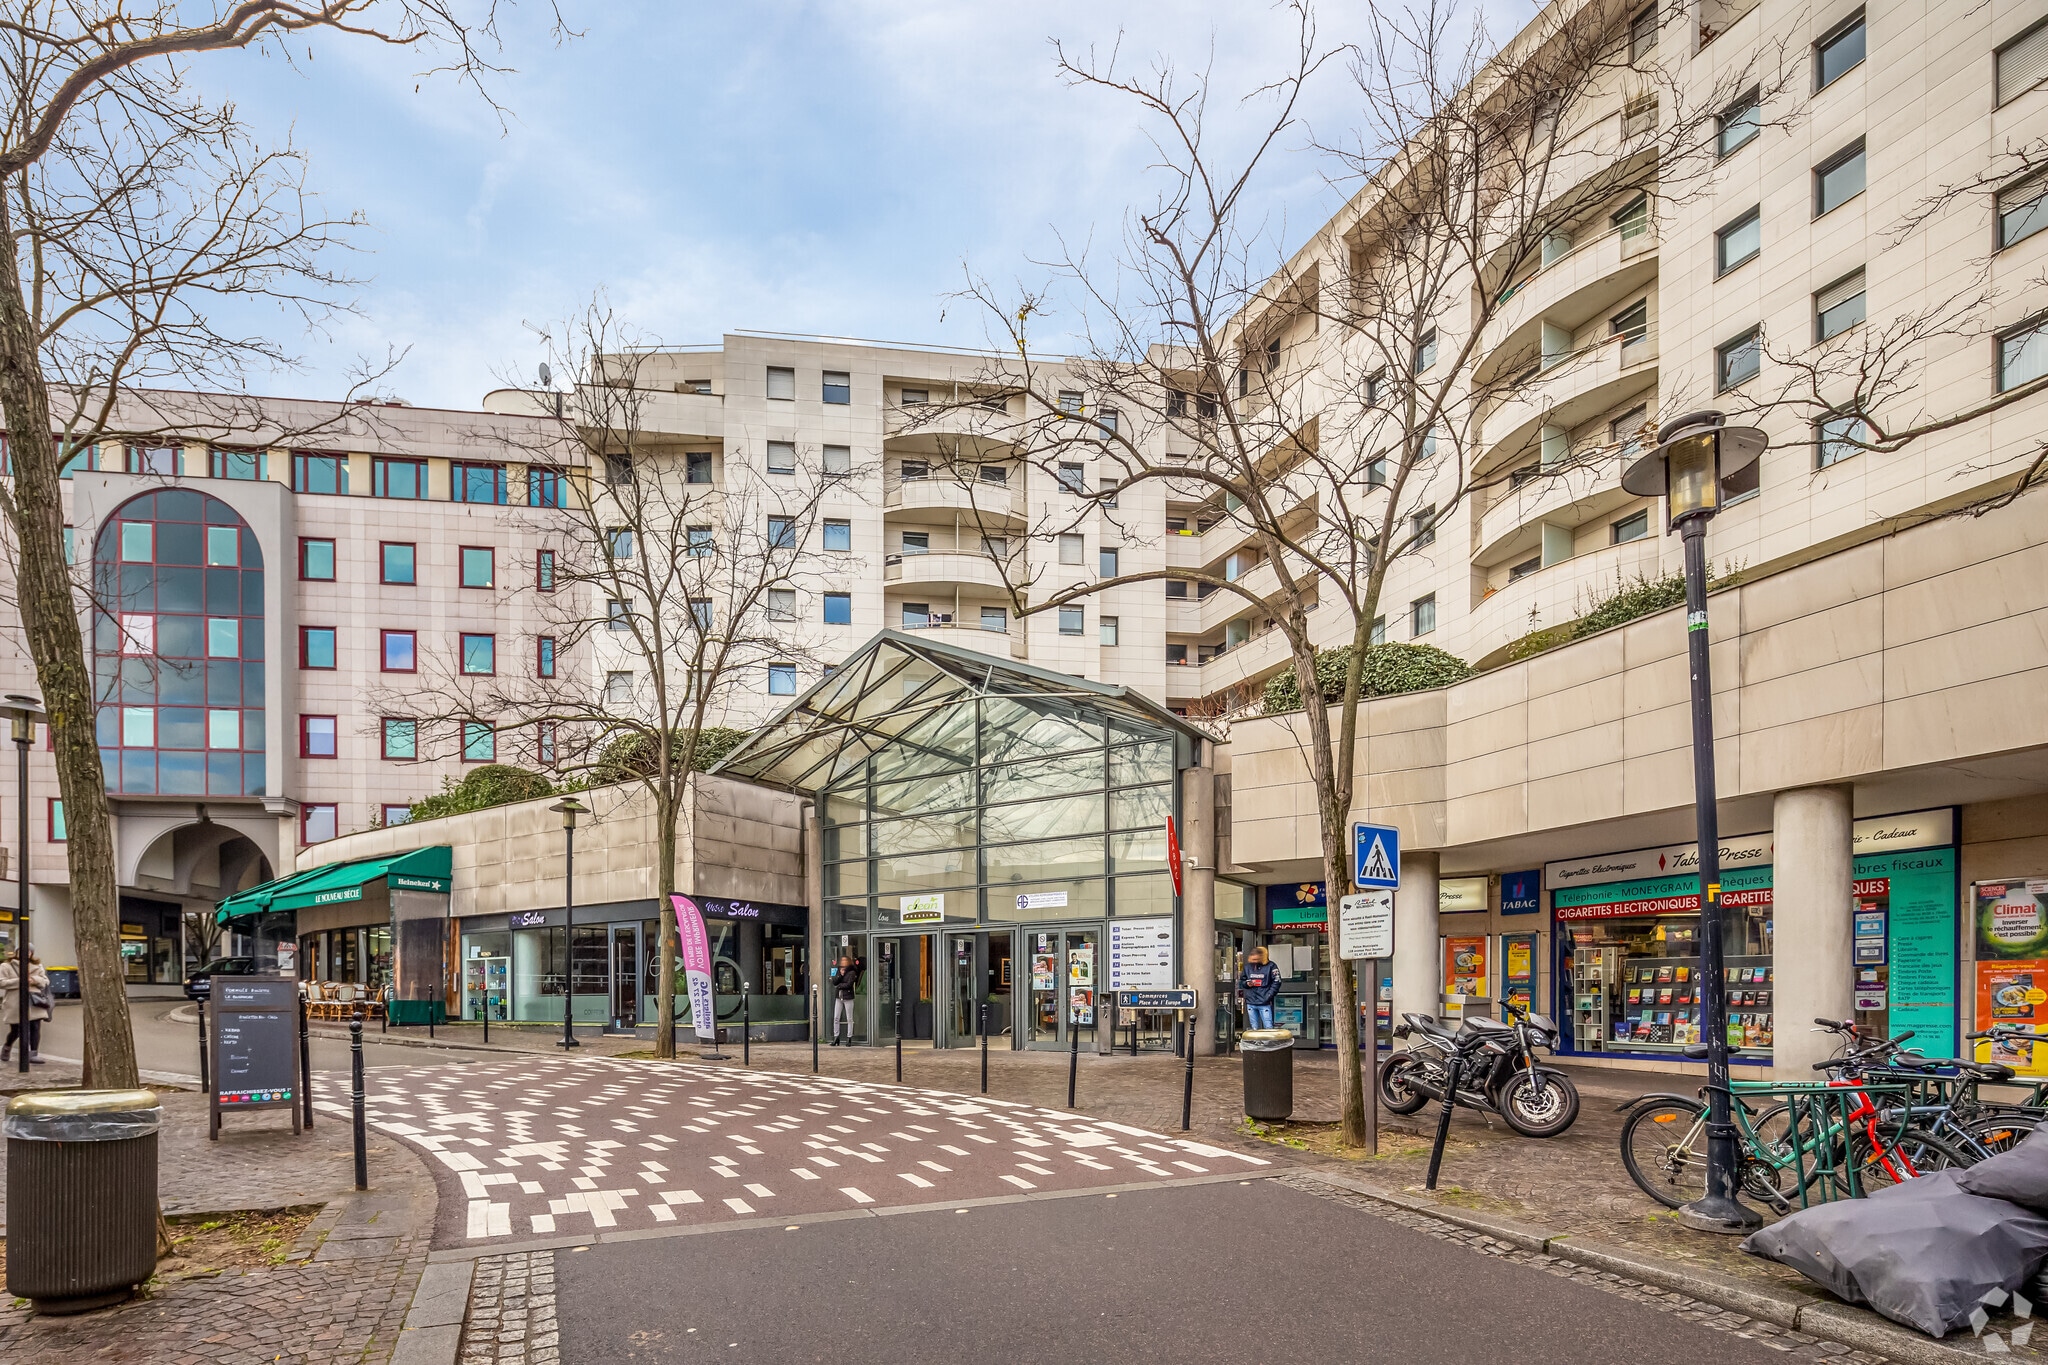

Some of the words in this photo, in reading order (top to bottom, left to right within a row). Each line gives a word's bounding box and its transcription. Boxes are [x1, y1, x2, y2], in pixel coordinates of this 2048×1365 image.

[1873, 828, 1918, 840] Cadeaux
[1170, 832, 1178, 880] TABAC
[1673, 852, 1700, 868] Taba
[1718, 848, 1762, 860] Presse
[1892, 858, 1943, 870] fiscaux
[1558, 868, 1590, 879] Cigarettes
[1592, 863, 1636, 875] Electroniques
[398, 878, 431, 887] Heineken
[1853, 881, 1884, 894] QUES
[321, 892, 343, 902] NOUVEAU
[344, 889, 359, 899] SIÈCLE
[1621, 882, 1693, 897] MONEYGRAM
[907, 897, 938, 910] clean
[1720, 890, 1773, 905] IGARETTES
[727, 902, 759, 917] Salon
[1502, 900, 1537, 910] TABAC
[1558, 904, 1612, 918] CIGARETTES
[1614, 897, 1698, 914] ELECTRONIQUES
[1994, 903, 2036, 915] Climat
[522, 912, 544, 926] Salon
[878, 913, 889, 922] lon
